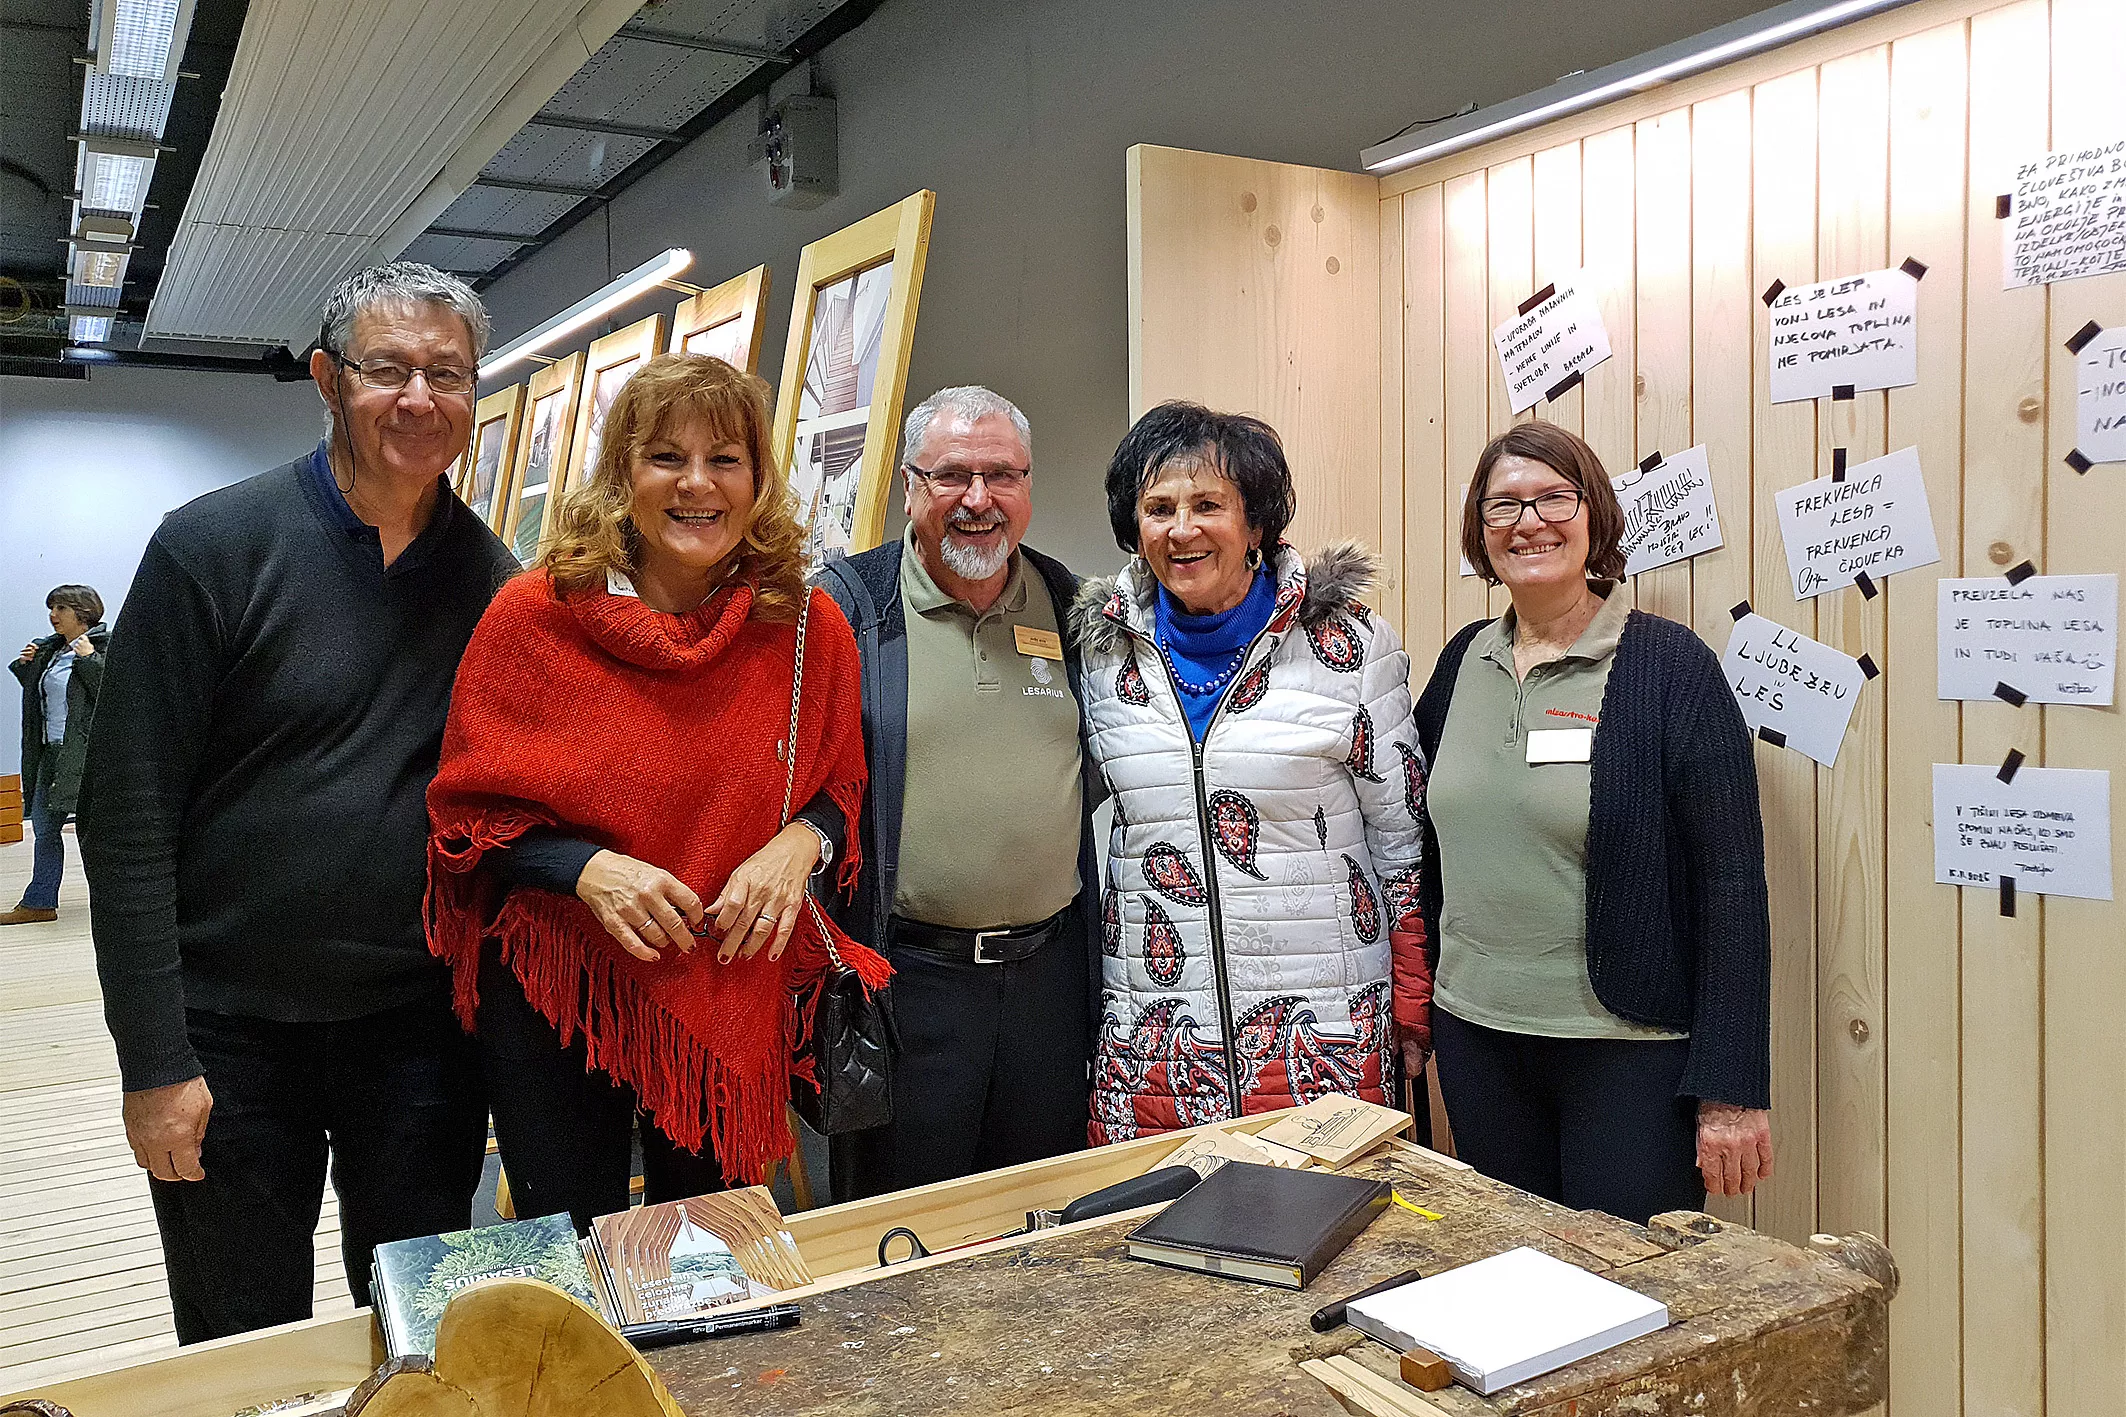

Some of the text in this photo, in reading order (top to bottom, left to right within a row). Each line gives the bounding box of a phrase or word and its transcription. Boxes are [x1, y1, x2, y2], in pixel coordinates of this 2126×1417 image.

[2017, 141, 2126, 180] ZA PRIHODNO
[2018, 158, 2126, 196] ČLOVEŠTVA B
[2057, 183, 2097, 199] KAKO
[2014, 228, 2036, 241] NA
[2040, 211, 2100, 236] OKOLJE
[1538, 287, 1575, 317] NARAVNIH
[1774, 294, 1802, 309] LES
[1809, 288, 1826, 301] JE
[1774, 298, 1886, 327] VONJ LESA IN
[1848, 314, 1912, 334] TOPLINA
[1567, 322, 1578, 335] IN
[1503, 326, 1543, 362] MATERIALOV
[1563, 345, 1595, 372] BARBARA
[1513, 362, 1550, 393] SVETLOBA
[1795, 474, 1882, 518] FREKVENCA
[1658, 511, 1690, 534] BRAVO
[1829, 503, 1874, 527] LESA
[1806, 525, 1892, 561] FREKVENCA
[1952, 588, 2085, 603] PREVZELA NAS
[1954, 618, 2105, 632] JE TOPLINA LESA
[1771, 629, 1800, 654] LL
[1955, 648, 1971, 659] IN
[1983, 649, 2017, 663] TUDI
[1022, 687, 1065, 698] LESARIUS
[1735, 676, 1785, 711] LES
[2004, 808, 2029, 819] LESA
[2033, 810, 2075, 823] ODMEVA
[1958, 823, 1993, 835] SPOMIN
[1998, 826, 2013, 835] NA
[1960, 834, 1973, 846] ŠE
[634, 1275, 677, 1291] Lesene
[645, 1297, 713, 1321] preobrazbe
